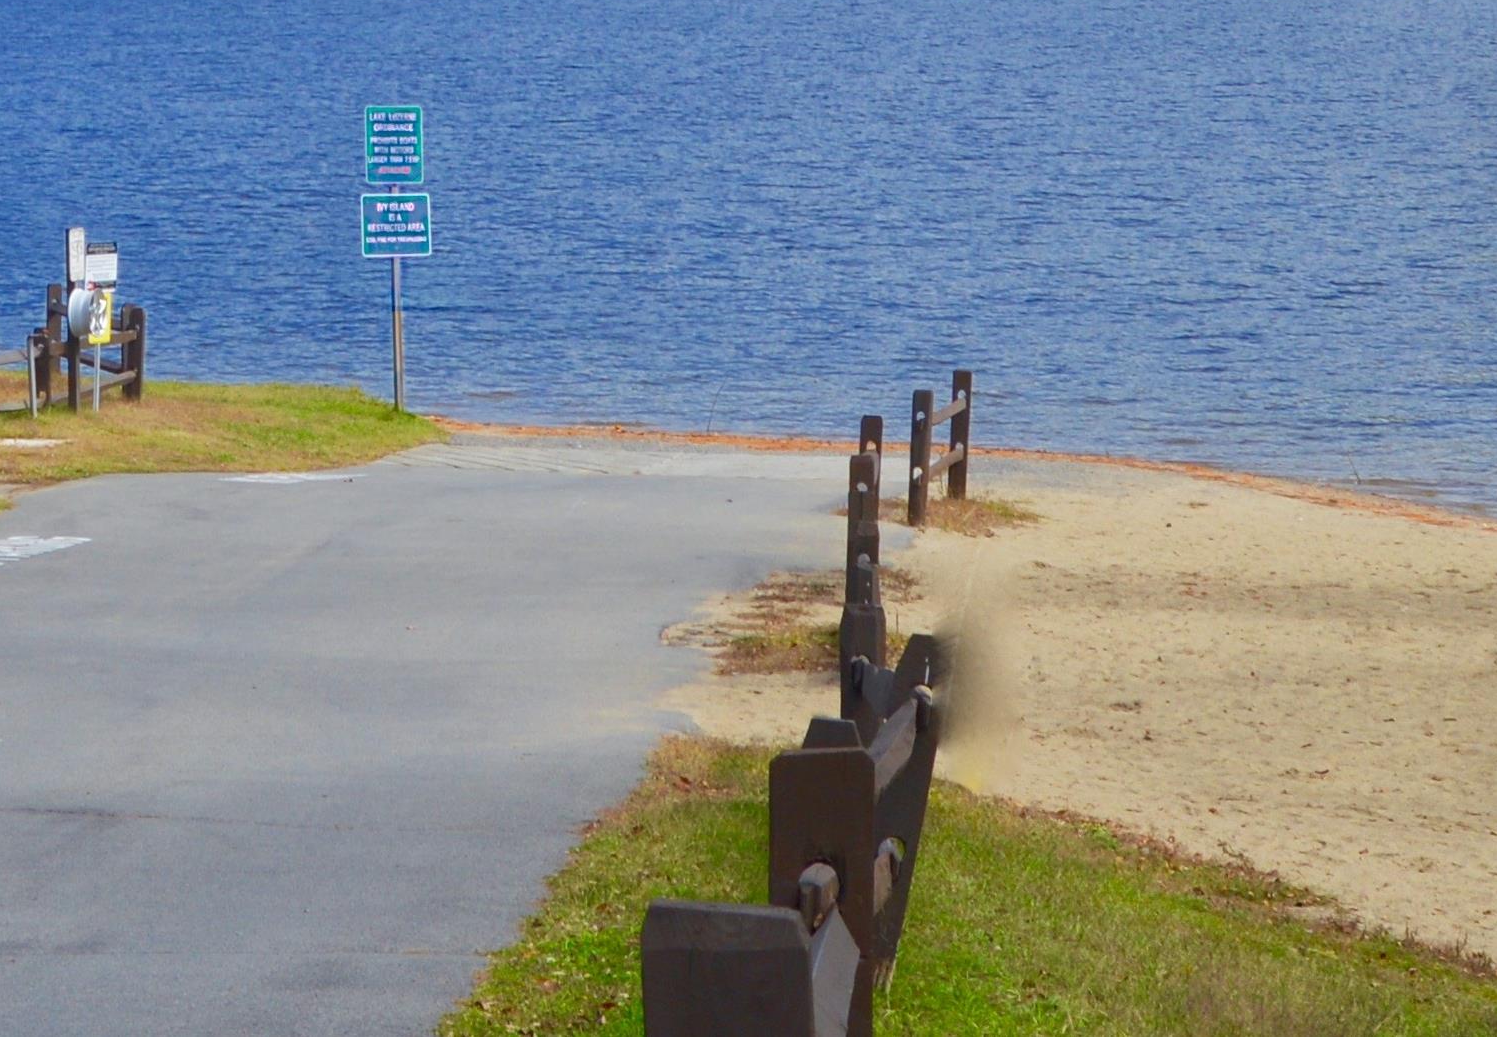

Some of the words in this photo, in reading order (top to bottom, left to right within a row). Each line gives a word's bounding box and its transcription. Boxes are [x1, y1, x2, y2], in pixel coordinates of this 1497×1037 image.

[389, 202, 415, 211] ISLAND
[388, 213, 395, 222] IS
[396, 213, 402, 221] A
[367, 223, 406, 232] RESTRICTED
[407, 222, 425, 232] AREA
